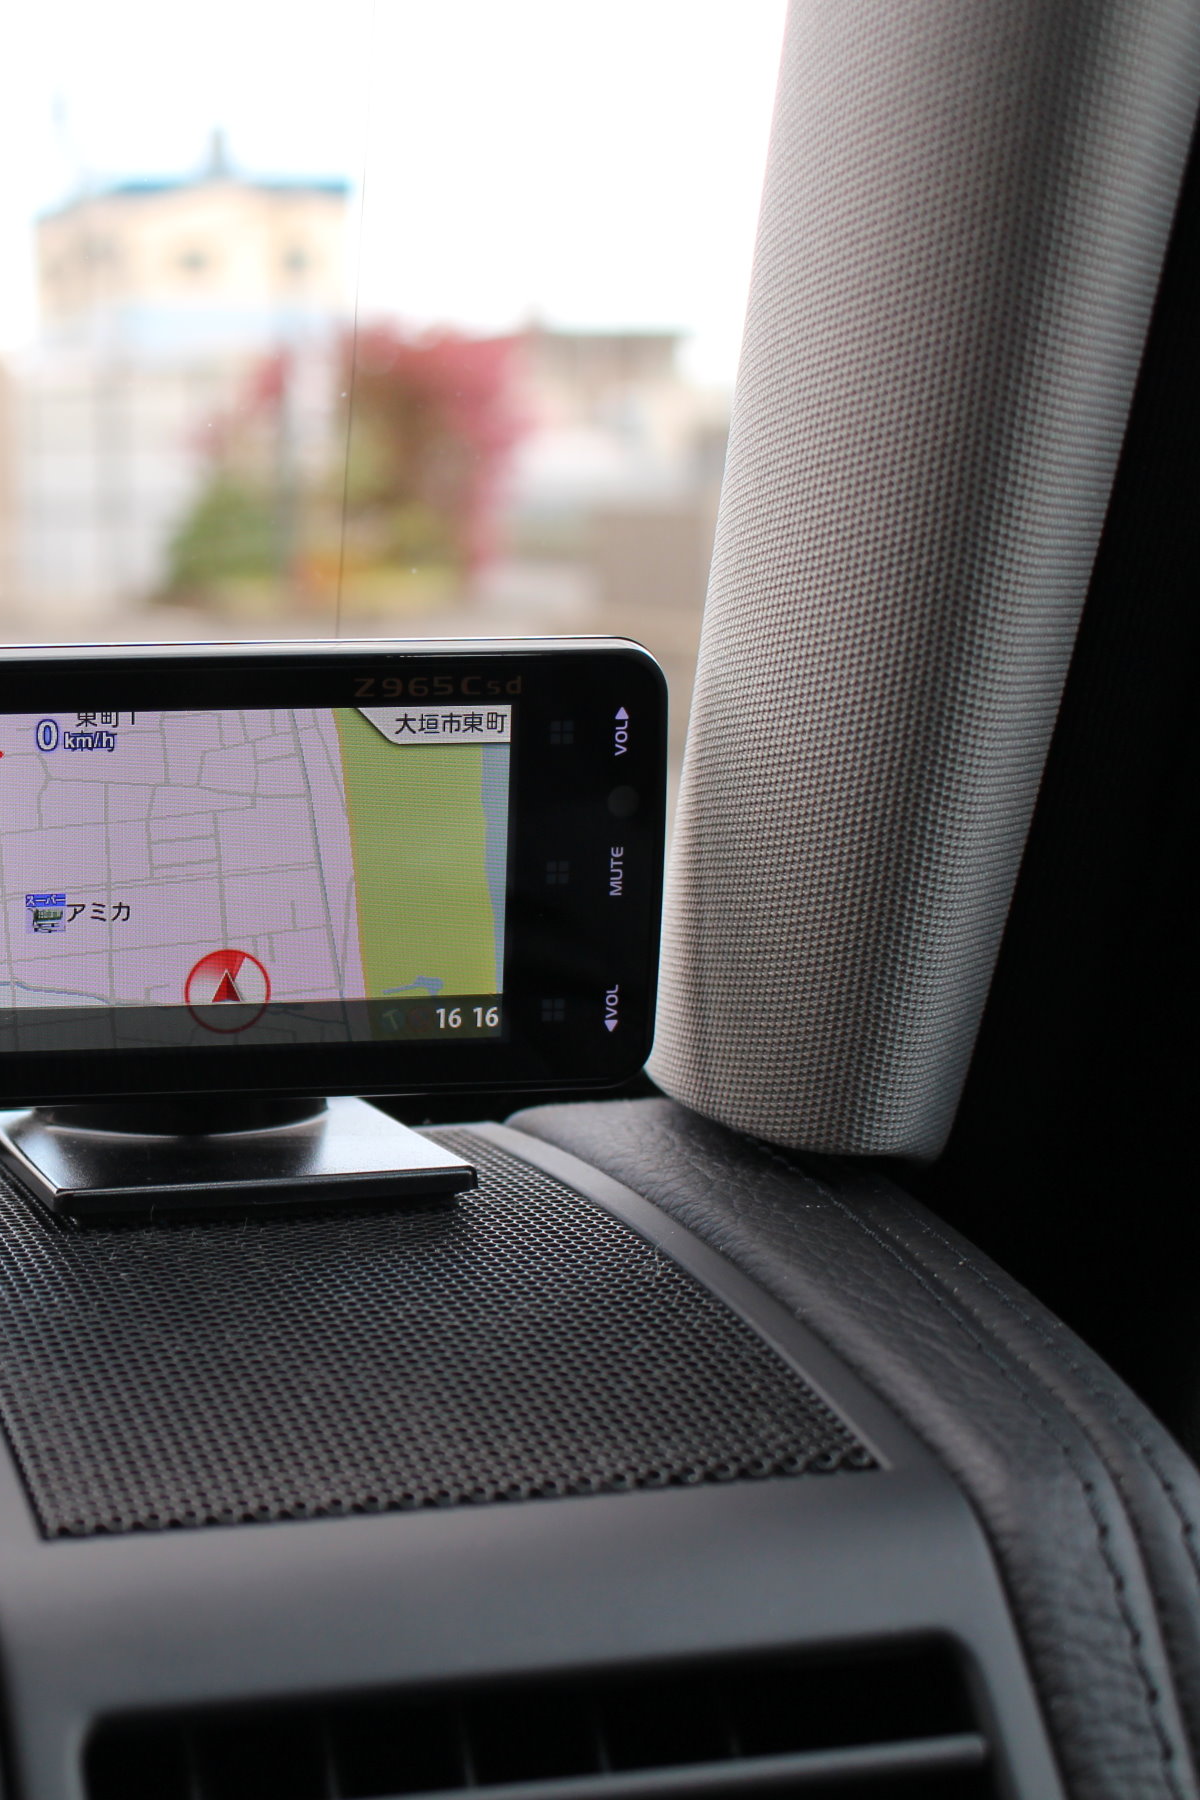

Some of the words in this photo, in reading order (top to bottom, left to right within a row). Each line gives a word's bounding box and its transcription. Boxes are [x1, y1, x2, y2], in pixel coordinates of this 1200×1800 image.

[355, 675, 523, 698] Z965Csd
[394, 712, 508, 735] 大垣市東町
[36, 719, 59, 752] 0
[63, 731, 115, 750] km/h
[614, 721, 629, 756] VOL
[609, 846, 624, 896] MUTE
[26, 894, 66, 906] スーパー
[66, 901, 131, 922] アミカ
[605, 984, 619, 1019] VOL
[436, 1007, 462, 1029] 16
[473, 1006, 499, 1028] 16
